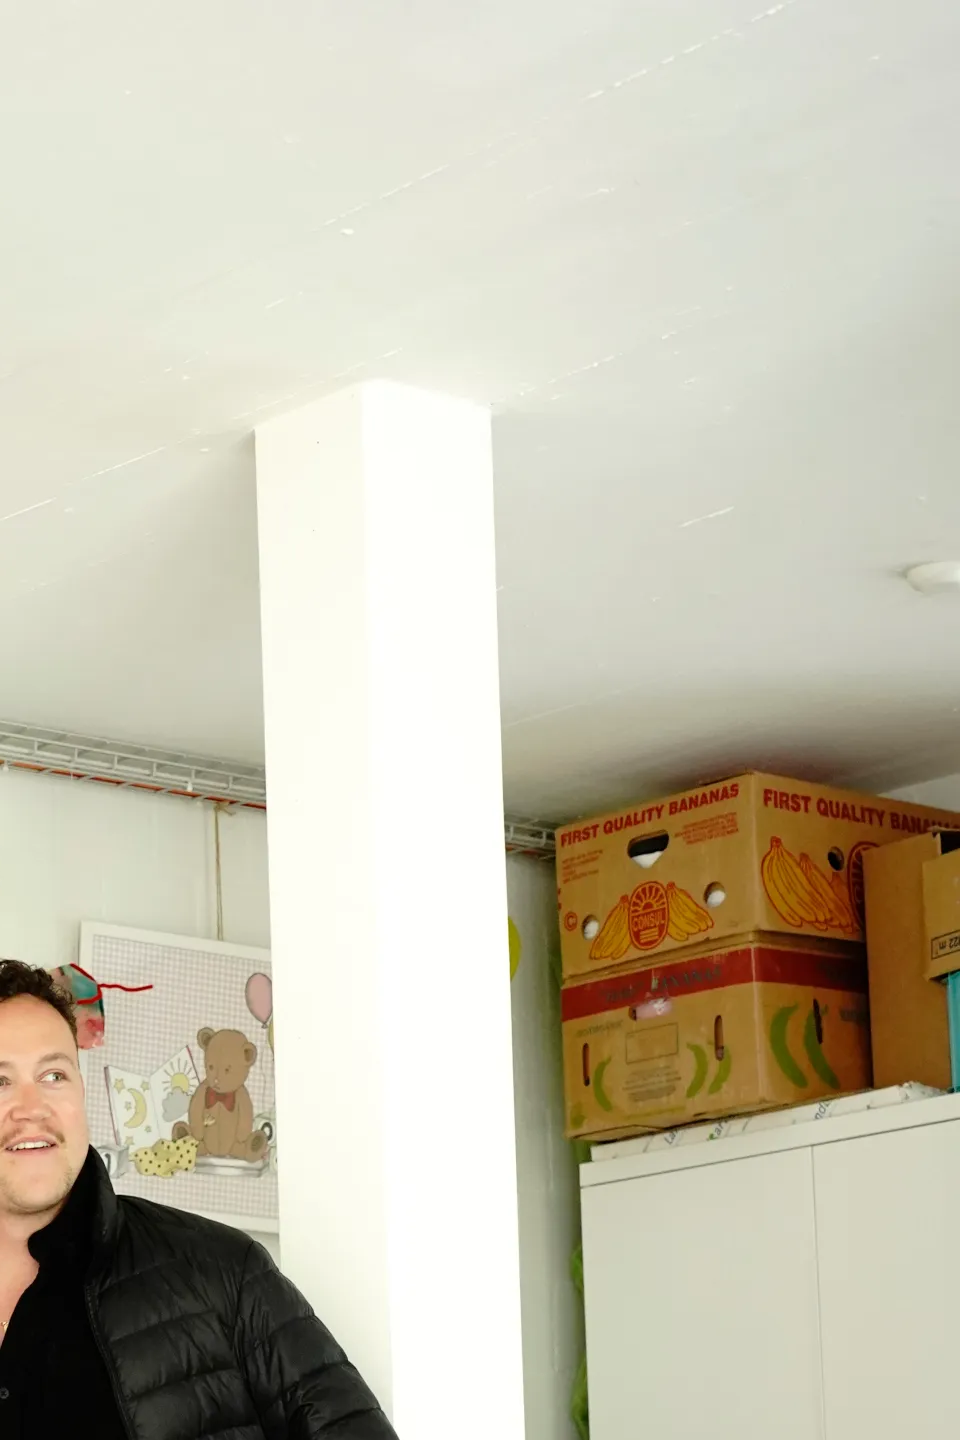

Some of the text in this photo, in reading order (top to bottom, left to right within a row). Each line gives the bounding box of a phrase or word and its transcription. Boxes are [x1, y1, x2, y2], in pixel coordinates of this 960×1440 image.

[561, 824, 600, 847] FIRST
[603, 804, 664, 835] QUALITY
[669, 783, 739, 816] BANANAS
[763, 788, 811, 814] FIRST
[816, 797, 886, 827] QUALITY
[632, 911, 665, 931] CONSUL
